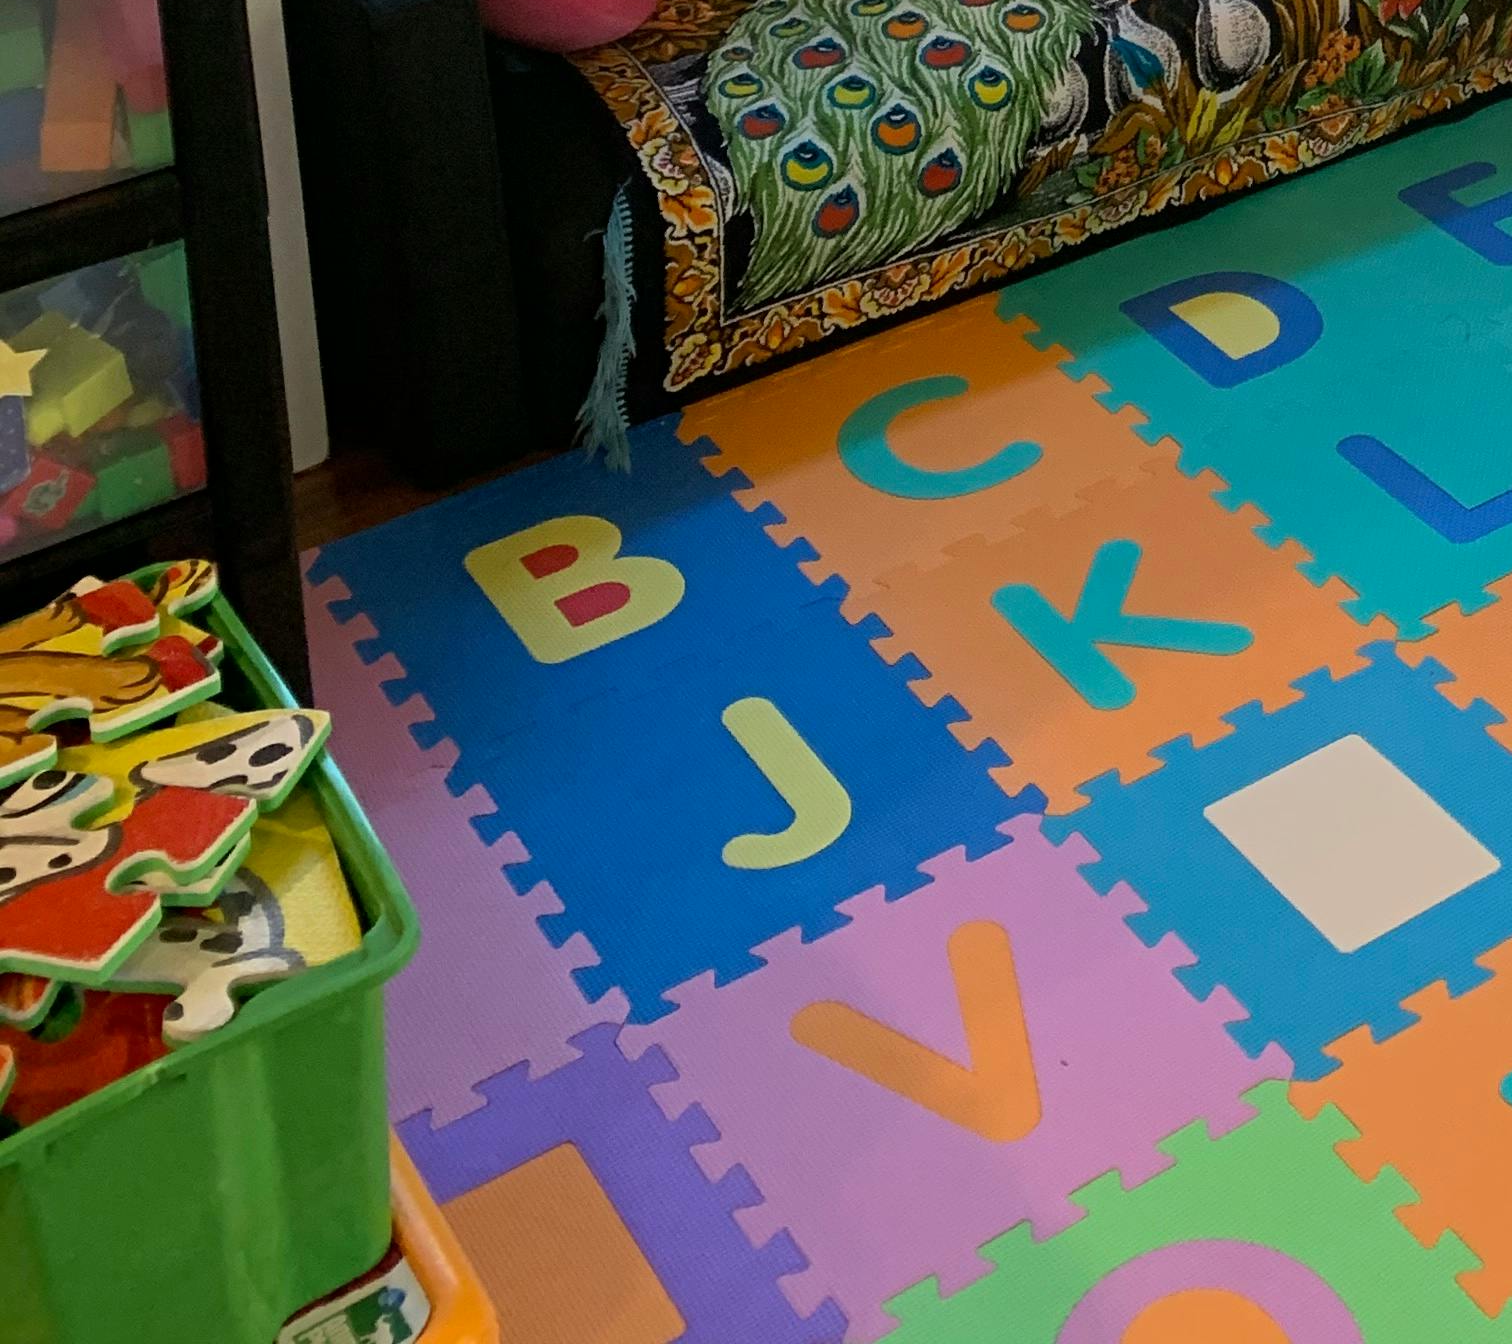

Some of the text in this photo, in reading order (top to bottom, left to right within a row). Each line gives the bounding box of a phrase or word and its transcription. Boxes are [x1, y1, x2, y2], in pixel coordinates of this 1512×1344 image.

[463, 515, 686, 664] B
[837, 375, 1044, 500] C
[1119, 271, 1325, 389] D
[721, 697, 852, 870] J
[991, 539, 1254, 710] K
[790, 920, 1042, 1143] V
